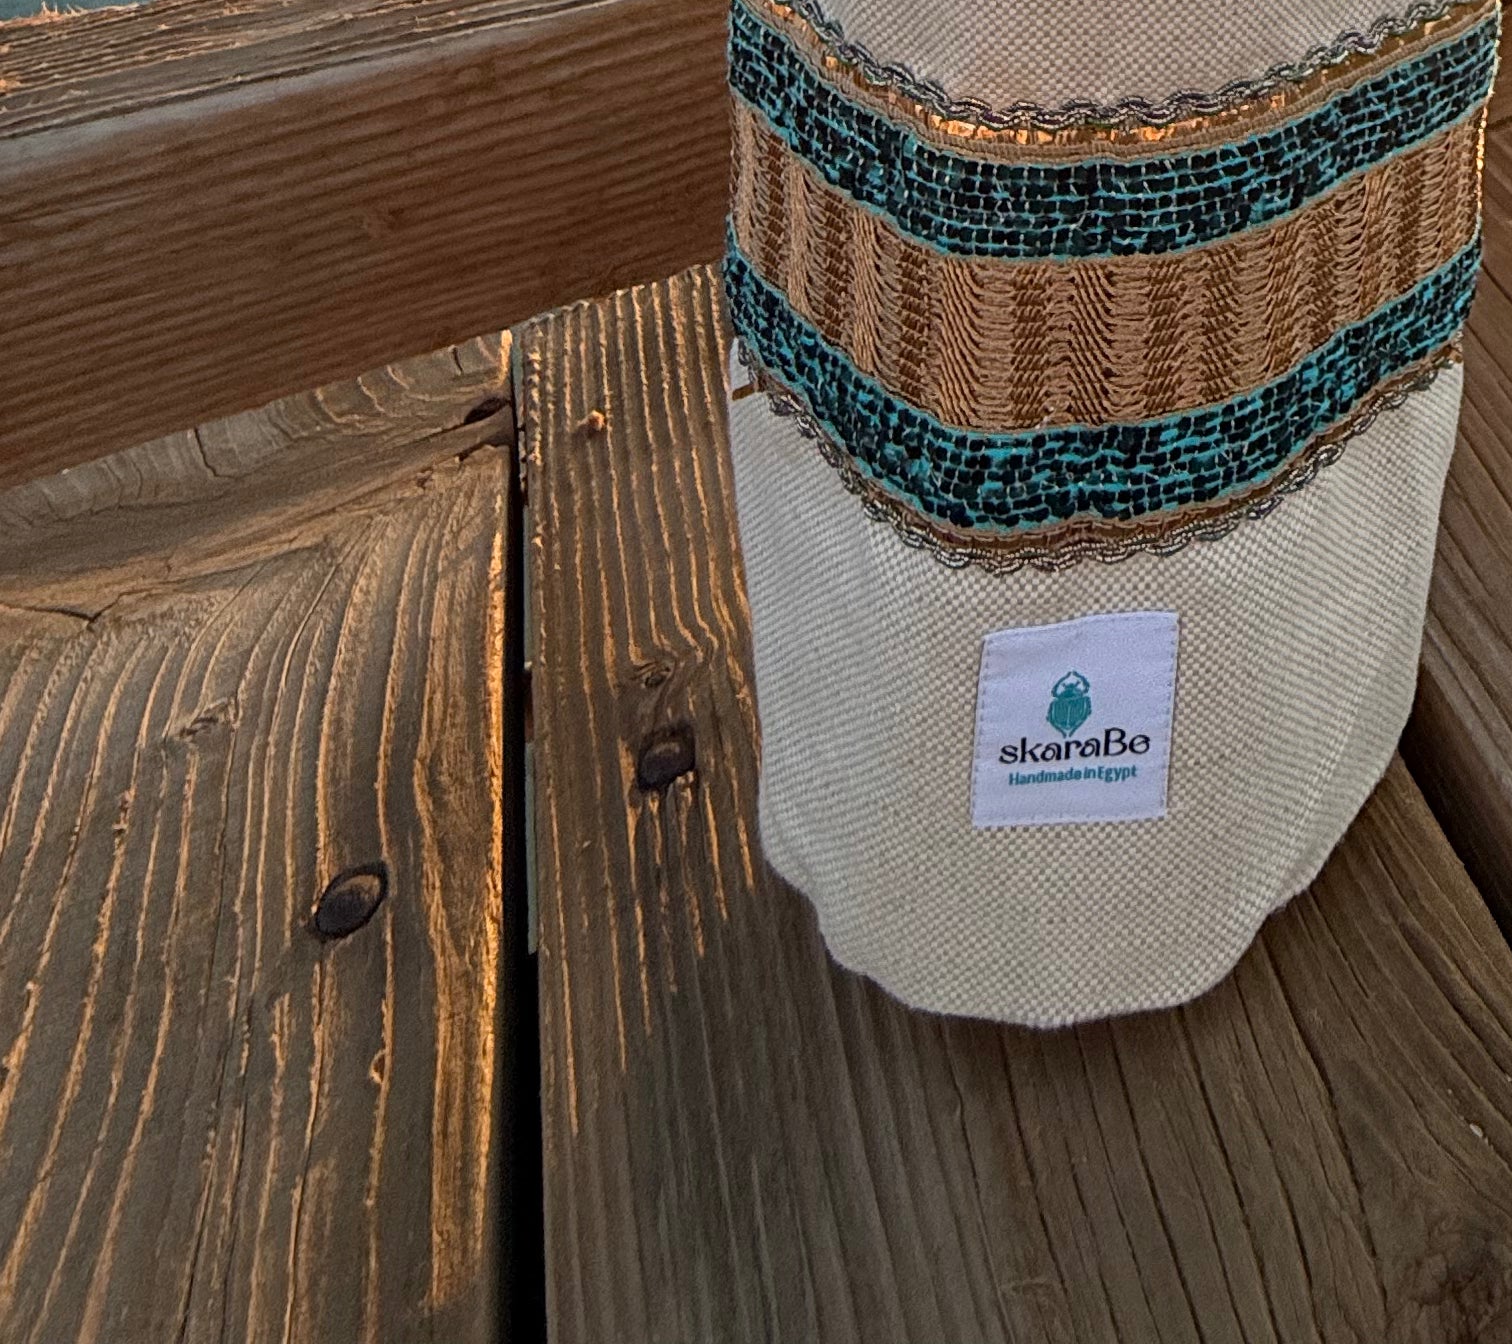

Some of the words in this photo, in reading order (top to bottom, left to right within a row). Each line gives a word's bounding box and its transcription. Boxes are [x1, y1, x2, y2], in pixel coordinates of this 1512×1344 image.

[998, 727, 1151, 765] skaraBe
[1008, 767, 1082, 786] Handmade
[1083, 766, 1096, 780] in
[1097, 764, 1138, 783] Egypt
